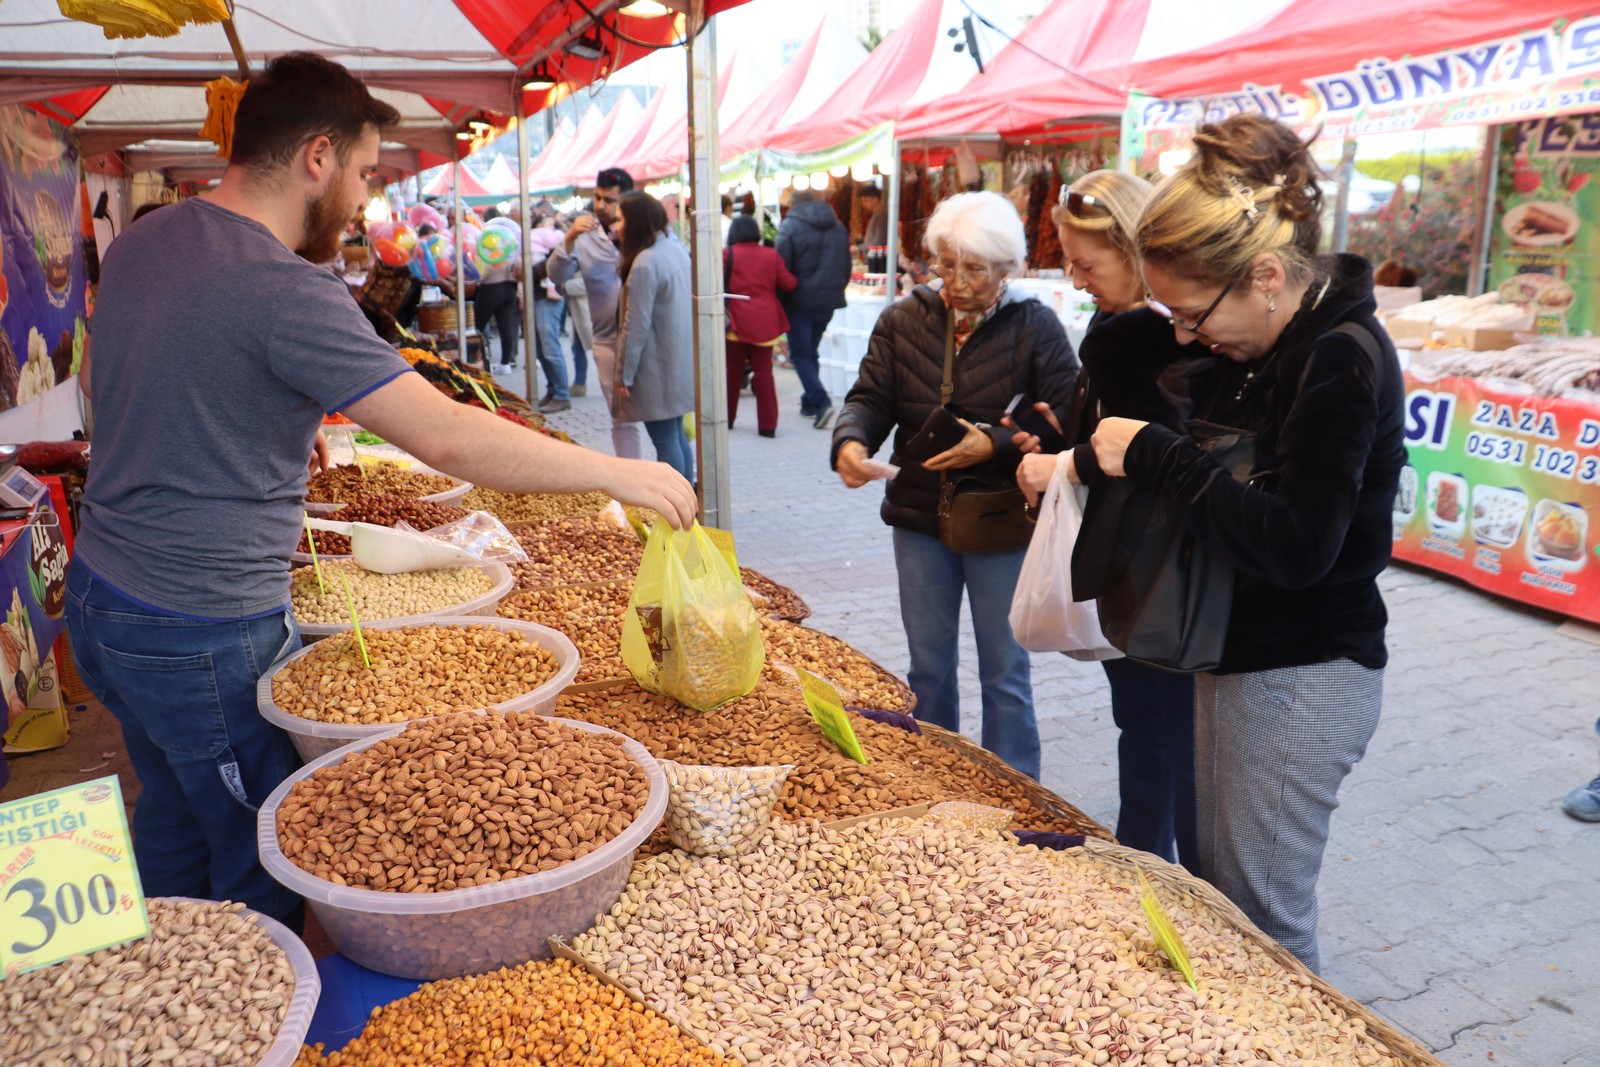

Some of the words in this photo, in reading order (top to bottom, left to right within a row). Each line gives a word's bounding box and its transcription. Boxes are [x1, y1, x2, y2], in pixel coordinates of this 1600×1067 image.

[1453, 106, 1500, 121] 0531
[1510, 97, 1547, 113] 102
[1476, 403, 1556, 436] ZAZA
[1468, 435, 1524, 462] 0531
[1534, 448, 1576, 475] 102
